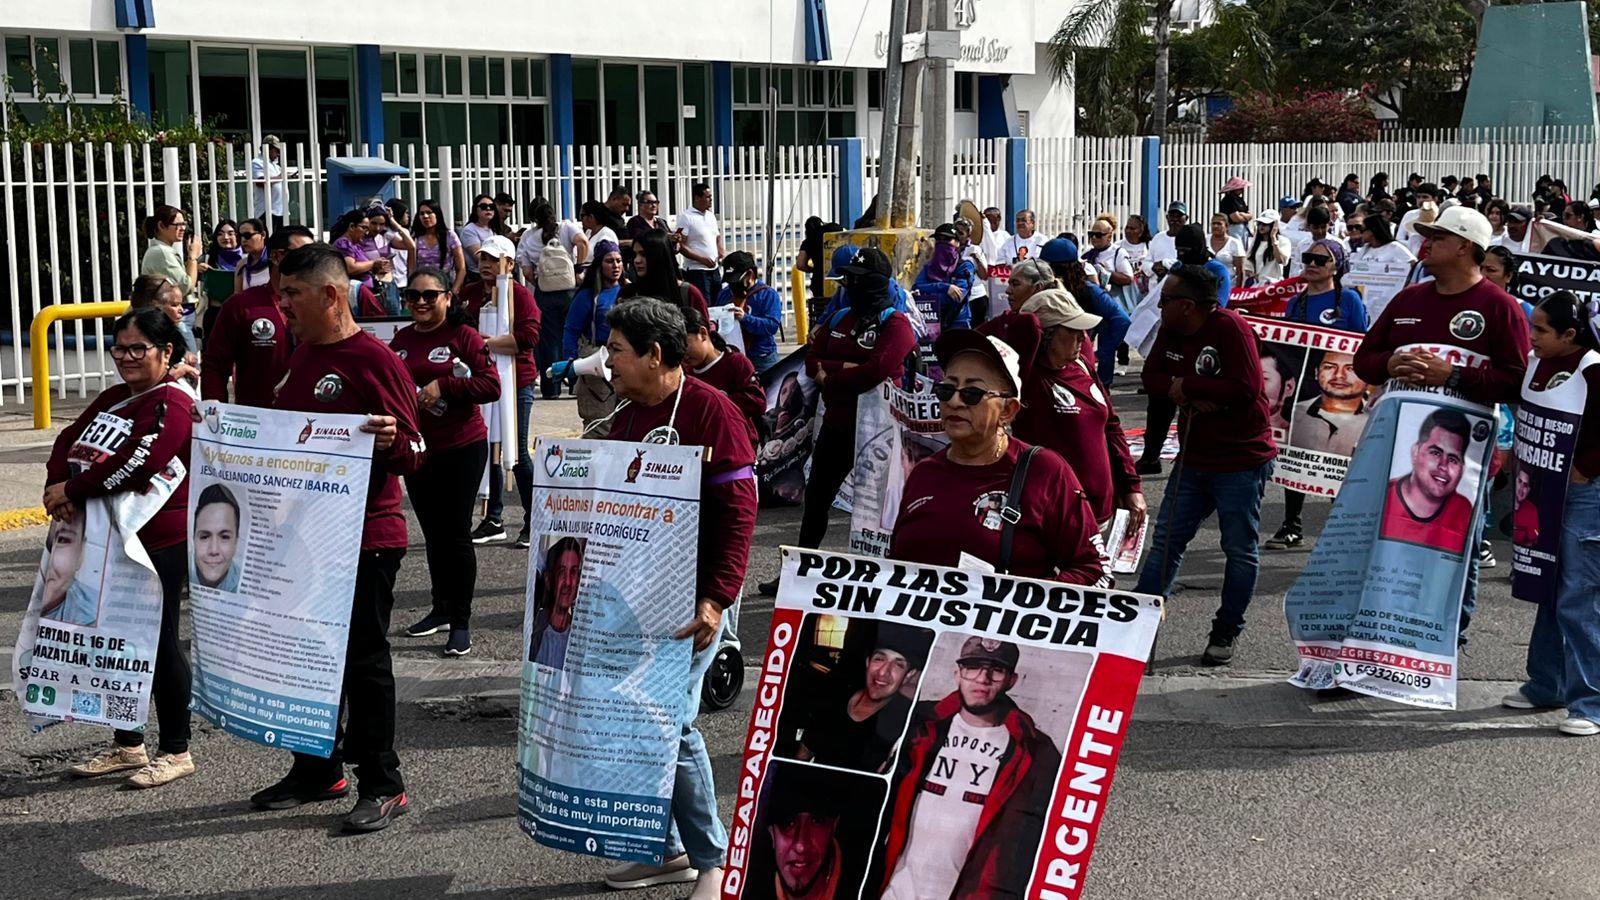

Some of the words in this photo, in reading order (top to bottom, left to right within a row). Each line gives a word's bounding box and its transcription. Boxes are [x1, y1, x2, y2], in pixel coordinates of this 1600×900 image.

[1258, 324, 1361, 353] SAPARECI
[218, 422, 257, 440] Sinaloa
[314, 427, 351, 437] SINALOA
[1544, 418, 1574, 435] RIESGO
[1542, 431, 1557, 448] ES
[266, 459, 330, 474] encontrar
[335, 464, 347, 476] a
[559, 463, 589, 479] Sinaloa
[644, 462, 684, 475] SINALOA
[1307, 470, 1318, 478] DE
[102, 467, 132, 490] todos
[262, 474, 303, 490] SANCHEZ
[304, 482, 350, 495] IBARRA
[1325, 488, 1336, 496] A
[596, 500, 659, 521] encontrar
[662, 508, 675, 524] a
[548, 520, 568, 533] JUAN
[594, 524, 651, 544] RODRÍGUEZ
[850, 538, 882, 556] CTUBRE
[796, 552, 882, 584] POR
[886, 564, 970, 597] LAS
[981, 575, 1140, 623] VOCES
[811, 582, 883, 614] SIN
[885, 592, 1100, 648] JUSTICIA
[1328, 613, 1336, 621] Y
[1358, 608, 1378, 618] ADO
[1378, 612, 1392, 621] DE
[1393, 613, 1404, 623] SU
[1310, 623, 1322, 632] DE
[1353, 619, 1378, 630] CALLE
[1380, 623, 1397, 633] DEL
[36, 625, 71, 645] ERTAD
[72, 633, 86, 648] EL
[90, 634, 105, 649] 16
[107, 637, 126, 652] DE
[1346, 632, 1389, 645] AZATLÁN,
[94, 655, 153, 674] SINALOA.
[1399, 657, 1407, 667] A
[1410, 657, 1451, 675] CASA!
[70, 674, 80, 685] A
[25, 683, 57, 706] 89
[266, 698, 286, 710] esta
[288, 702, 334, 719] persona,
[257, 708, 274, 721] muy
[275, 711, 333, 731] importante.
[724, 622, 793, 896] DESAPARECIDO
[933, 755, 959, 780] N
[969, 762, 990, 787] Y
[572, 795, 580, 805] a
[584, 795, 609, 809] esta
[613, 799, 667, 817] persona,
[558, 806, 569, 818] es
[570, 809, 594, 823] muy
[596, 812, 665, 831] importante.
